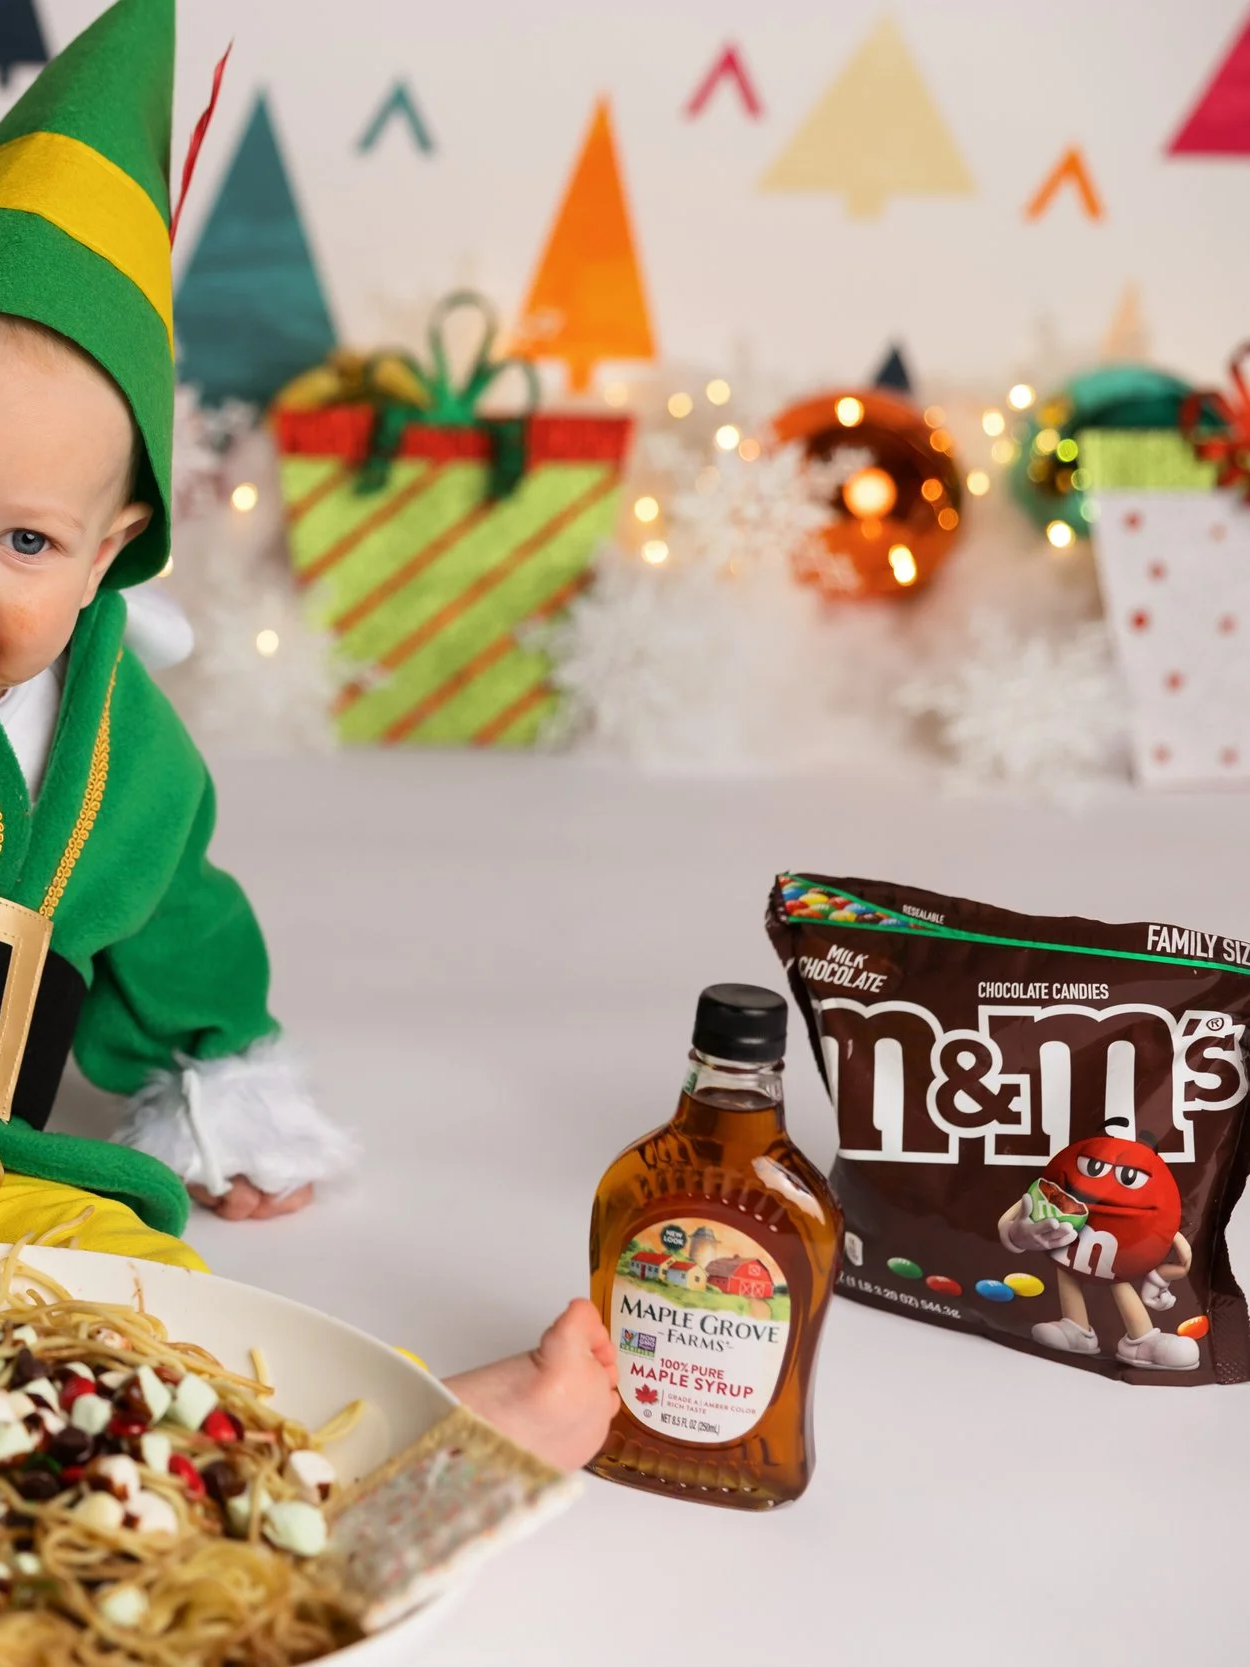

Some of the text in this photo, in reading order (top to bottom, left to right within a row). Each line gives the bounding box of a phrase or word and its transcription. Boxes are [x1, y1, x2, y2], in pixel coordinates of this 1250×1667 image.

[902, 904, 945, 924] RESEALABLE
[1147, 924, 1217, 958] FAMILY
[826, 944, 869, 969] MILK
[799, 956, 887, 993] CHOCOLATE
[978, 982, 1109, 1000] CHOCOLATE CANDIES
[663, 1236, 684, 1246] LOOK
[665, 1230, 682, 1239] NEW
[620, 1294, 781, 1343] MAPLE GROVE
[660, 1358, 724, 1380] 100% PURE
[630, 1361, 754, 1399] MAPLE SYRUP
[667, 1401, 707, 1414] RICH TASTE
[668, 1393, 691, 1404] GRADE
[704, 1401, 728, 1411] AMBER
[730, 1405, 756, 1414] COLOR
[661, 1412, 671, 1424] NET
[681, 1417, 688, 1429] FL
[689, 1419, 697, 1430] OZ
